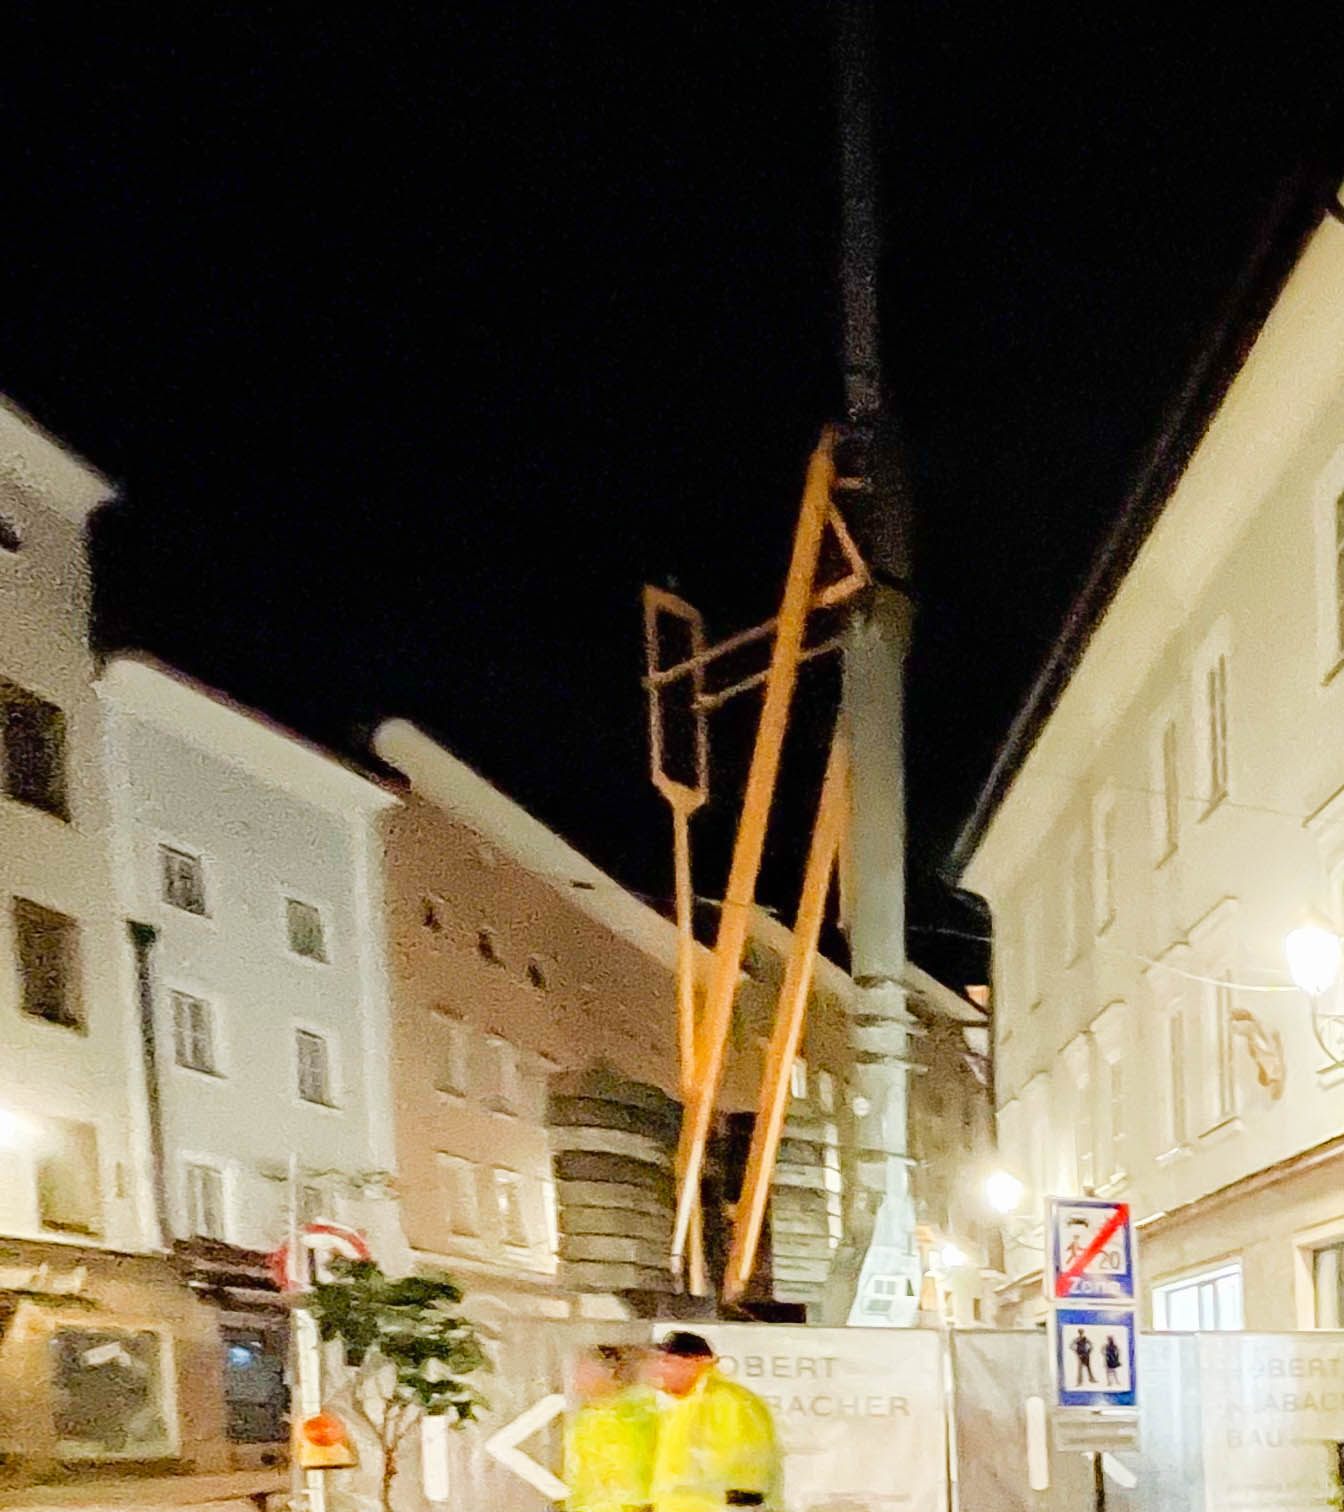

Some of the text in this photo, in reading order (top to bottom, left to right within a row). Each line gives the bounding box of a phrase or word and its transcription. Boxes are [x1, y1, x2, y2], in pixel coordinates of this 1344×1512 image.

[1099, 1250, 1121, 1270] 20
[1068, 1275, 1121, 1296] Zone
[716, 1354, 838, 1379] OBERT
